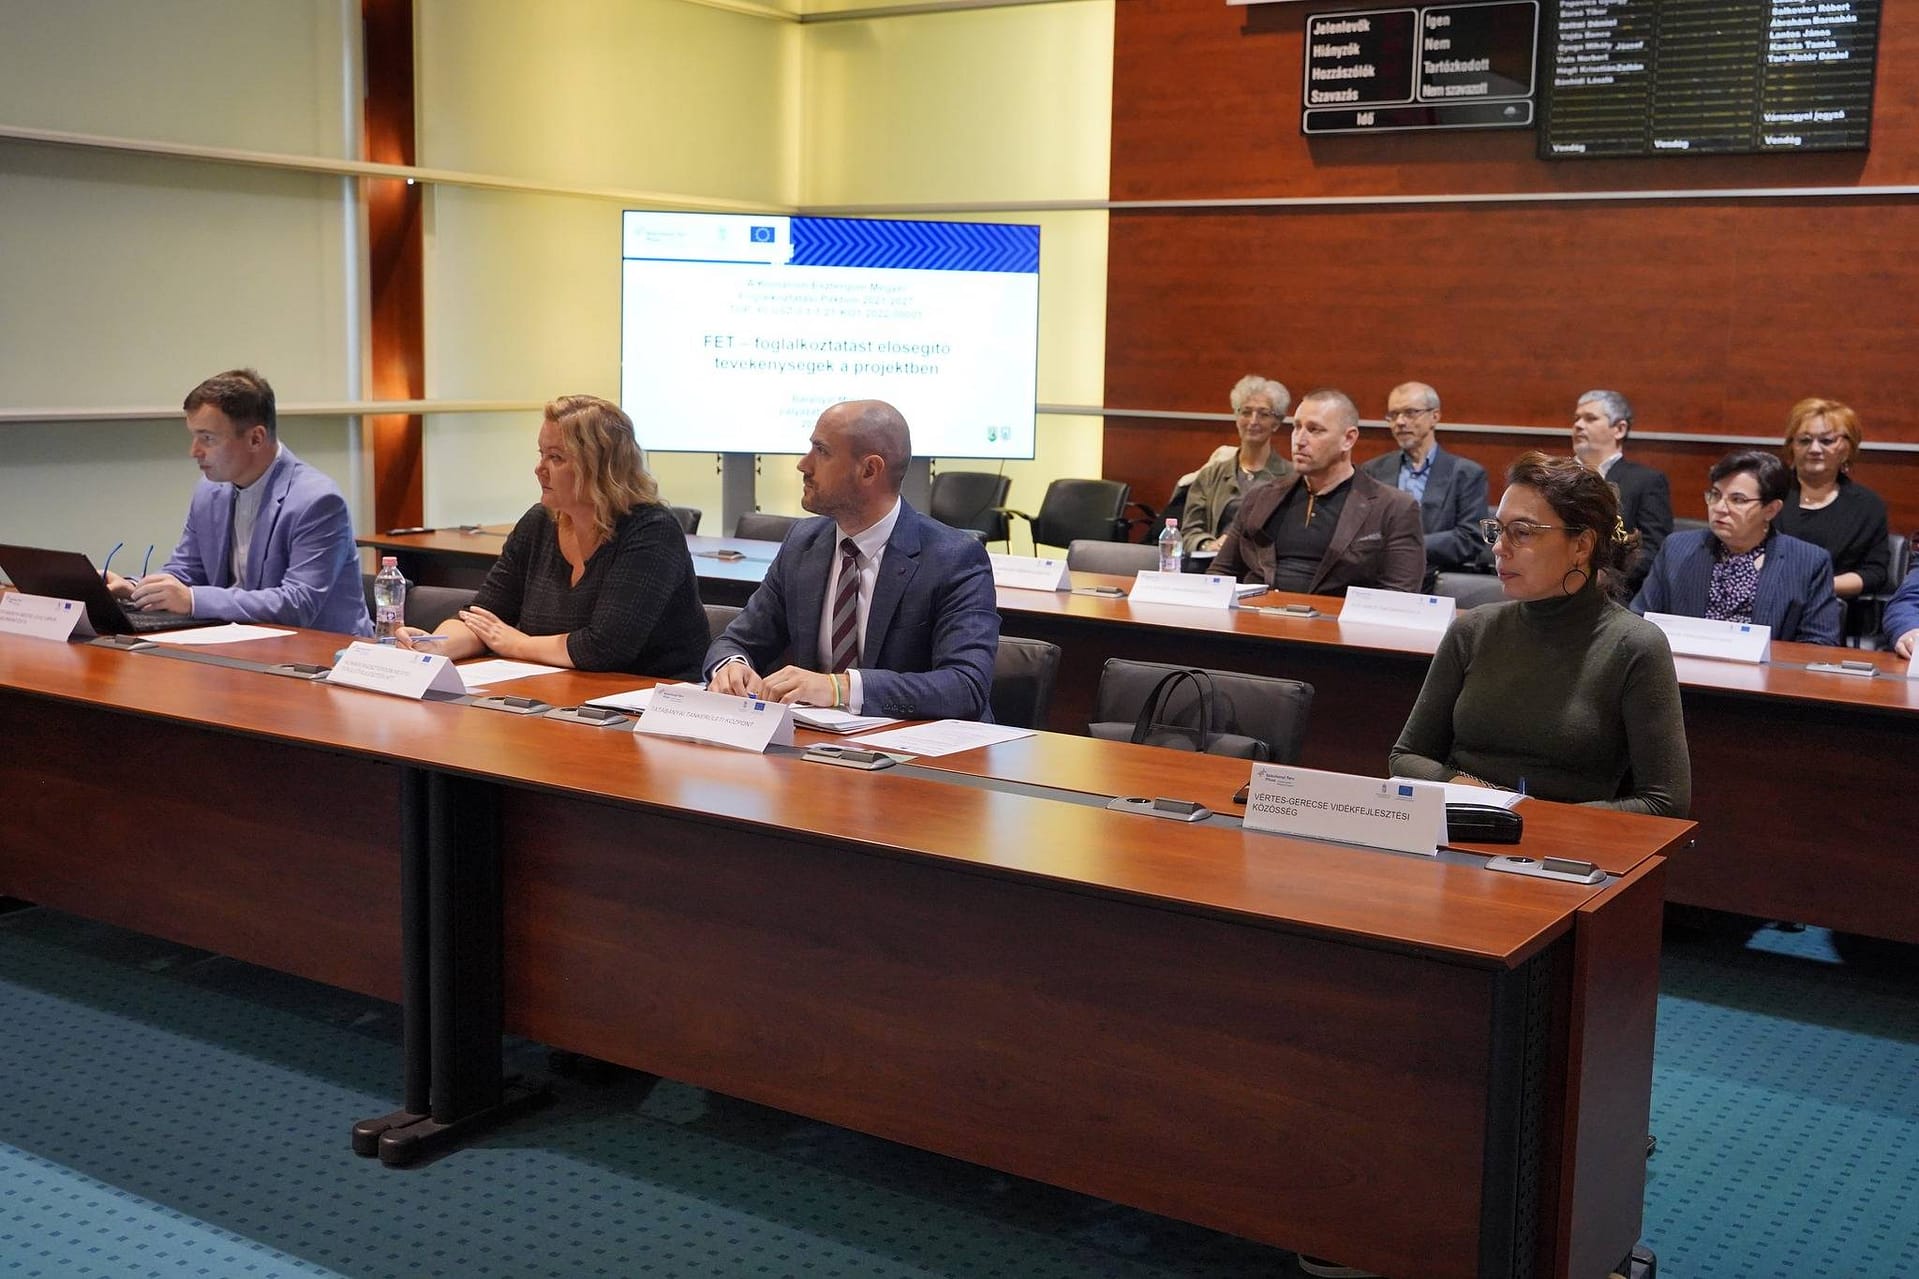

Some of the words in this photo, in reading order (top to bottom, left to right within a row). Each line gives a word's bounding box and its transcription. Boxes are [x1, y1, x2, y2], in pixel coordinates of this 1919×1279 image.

[1425, 15, 1450, 29] Igen
[1313, 43, 1360, 59] Hiányzók
[1425, 38, 1450, 50] Nem
[1311, 88, 1358, 103] Szavazás
[1422, 84, 1444, 98] Nem
[704, 335, 735, 349] FET
[840, 362, 848, 372] a
[854, 361, 939, 377] projektben
